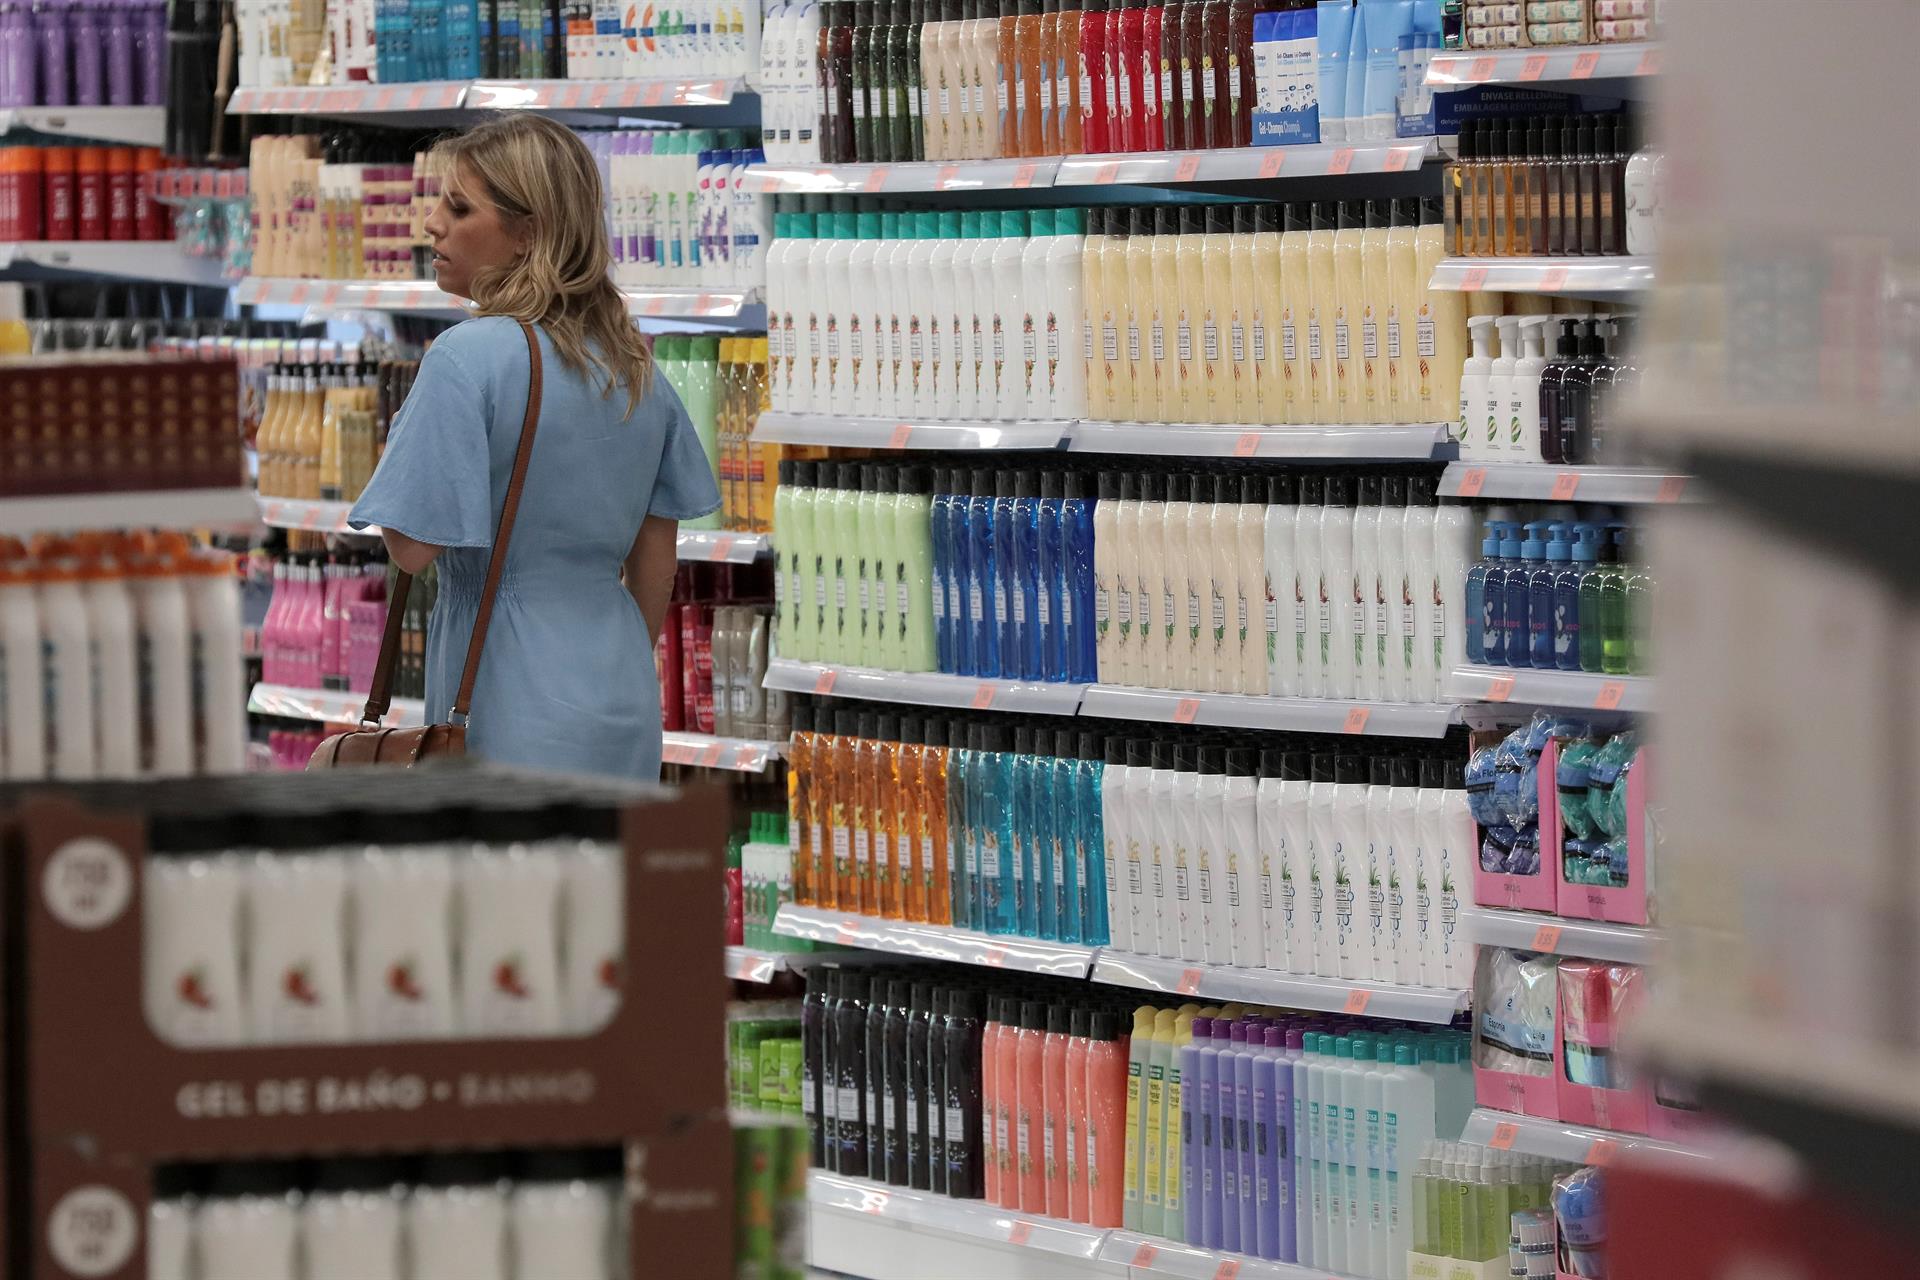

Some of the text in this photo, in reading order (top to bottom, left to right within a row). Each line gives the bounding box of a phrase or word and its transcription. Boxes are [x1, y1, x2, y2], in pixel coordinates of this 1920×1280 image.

[175, 1080, 246, 1119] GEL
[256, 1078, 307, 1117] DE
[316, 1068, 427, 1114] BAÑO
